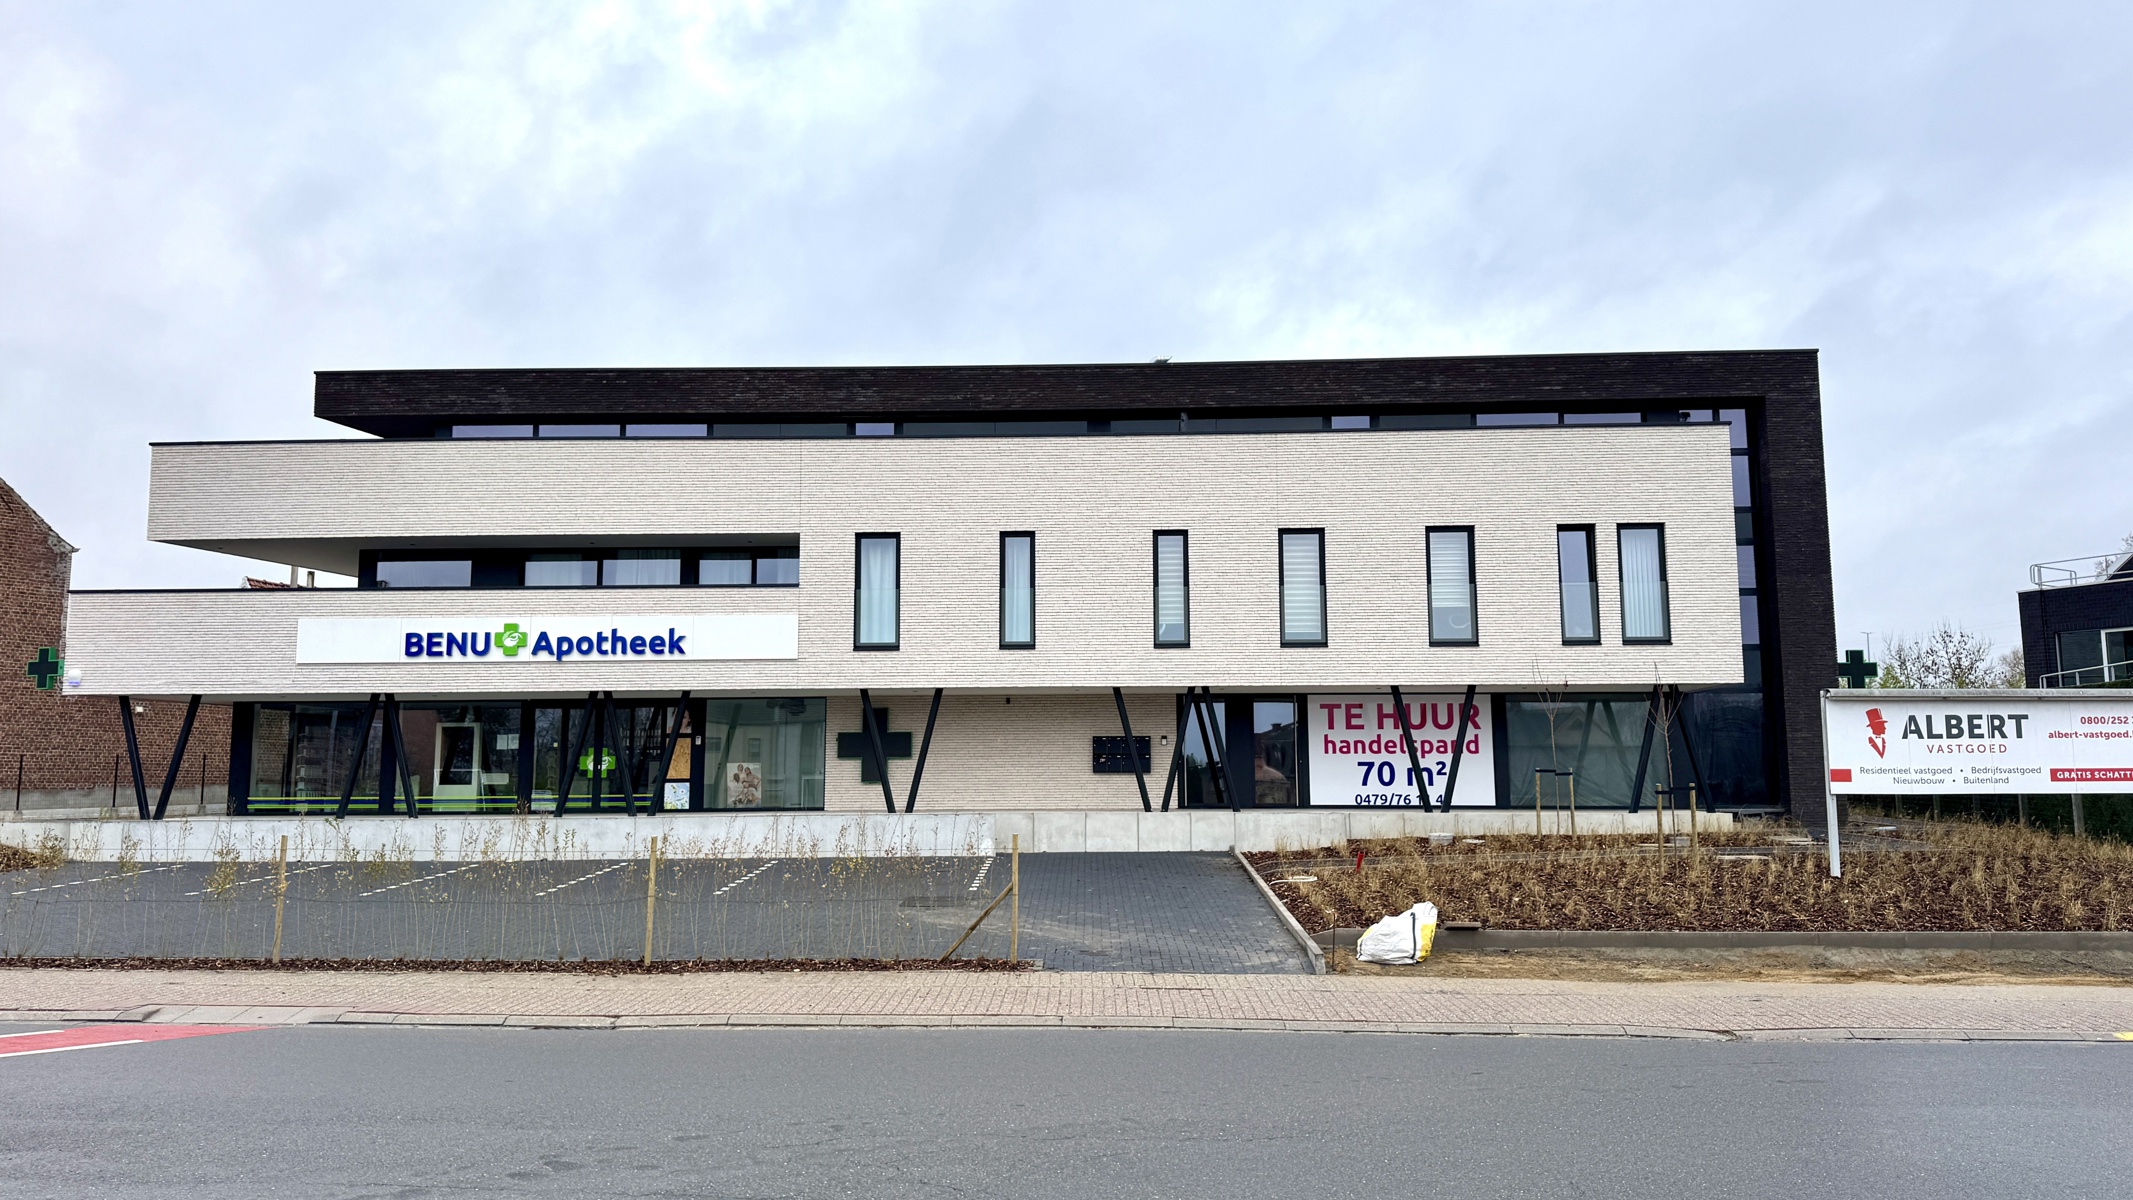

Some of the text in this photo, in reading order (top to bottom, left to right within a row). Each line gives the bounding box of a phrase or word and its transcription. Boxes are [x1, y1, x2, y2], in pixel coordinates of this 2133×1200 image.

[404, 628, 686, 661] BENU Apotheek
[1320, 703, 1481, 730] TE HUUR
[2080, 715, 2129, 725] 0800/252
[1902, 714, 2029, 739] ALBERT
[2048, 730, 2133, 740] albert-vastgoed.
[1926, 744, 2008, 754] VASTGOED
[1357, 761, 1396, 787] 70
[1859, 766, 2042, 776] Residentieel vastgoed Bedrijfsvastgoed
[2056, 770, 2133, 779] GRATIS SCHATT
[1893, 776, 2010, 785] Nieuwbouw Buitenland
[1354, 793, 1412, 806] 0479/76
